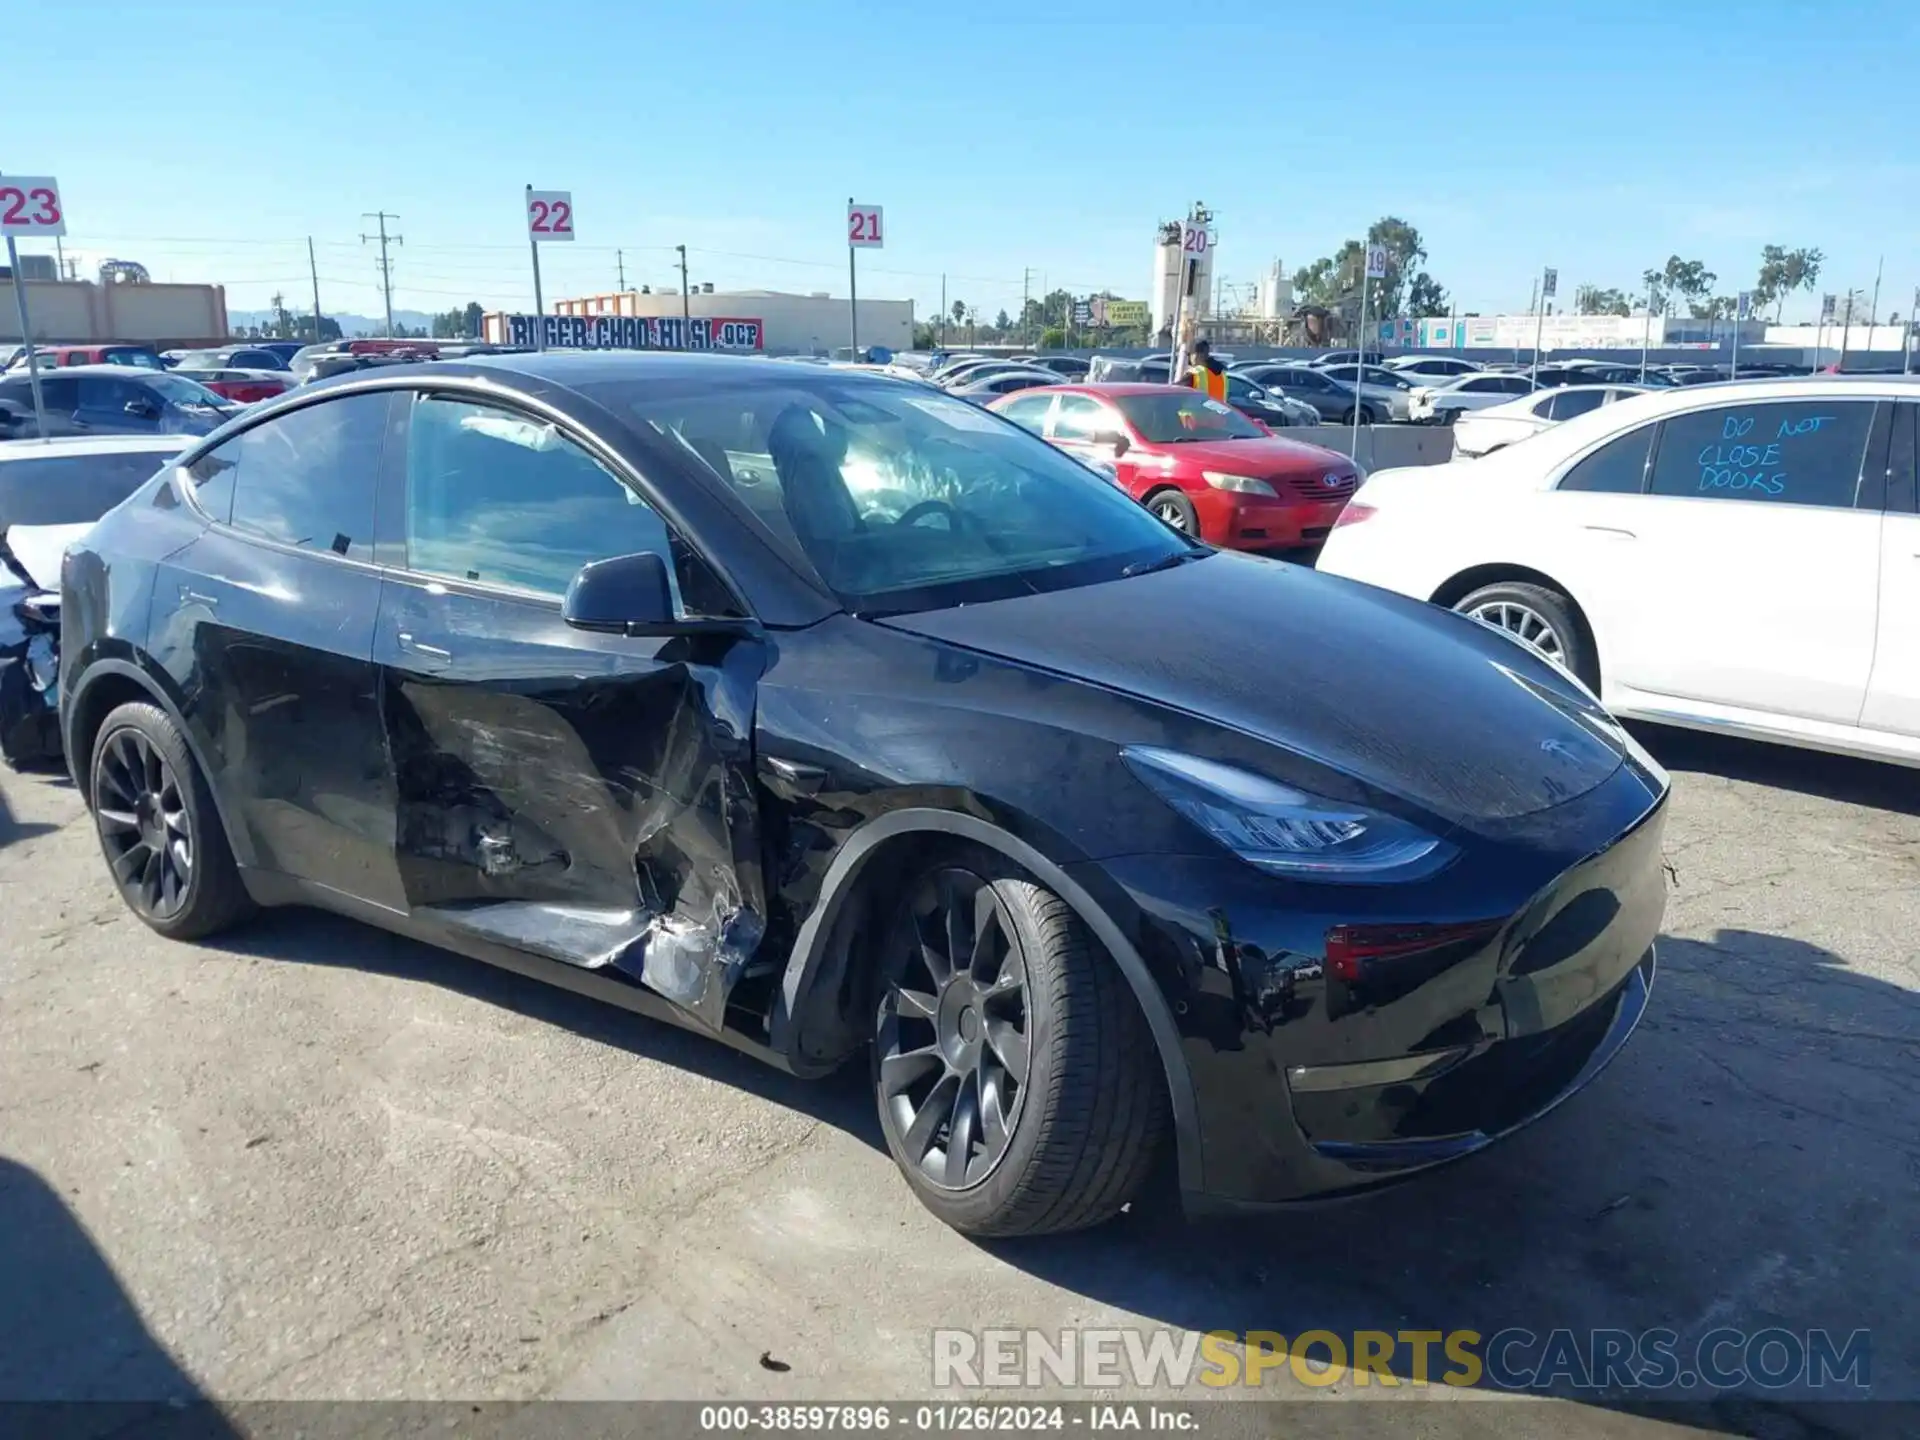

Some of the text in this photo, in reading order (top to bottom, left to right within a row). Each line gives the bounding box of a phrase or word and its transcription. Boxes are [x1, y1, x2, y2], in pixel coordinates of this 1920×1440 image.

[0, 187, 60, 225] 23
[530, 201, 572, 232] 22
[850, 212, 882, 240] 21
[1184, 229, 1207, 253] 20
[1368, 251, 1385, 272] 19
[1722, 416, 1837, 439] DO NOT
[1698, 443, 1780, 468] CLOSE
[1699, 466, 1787, 494] DOORS
